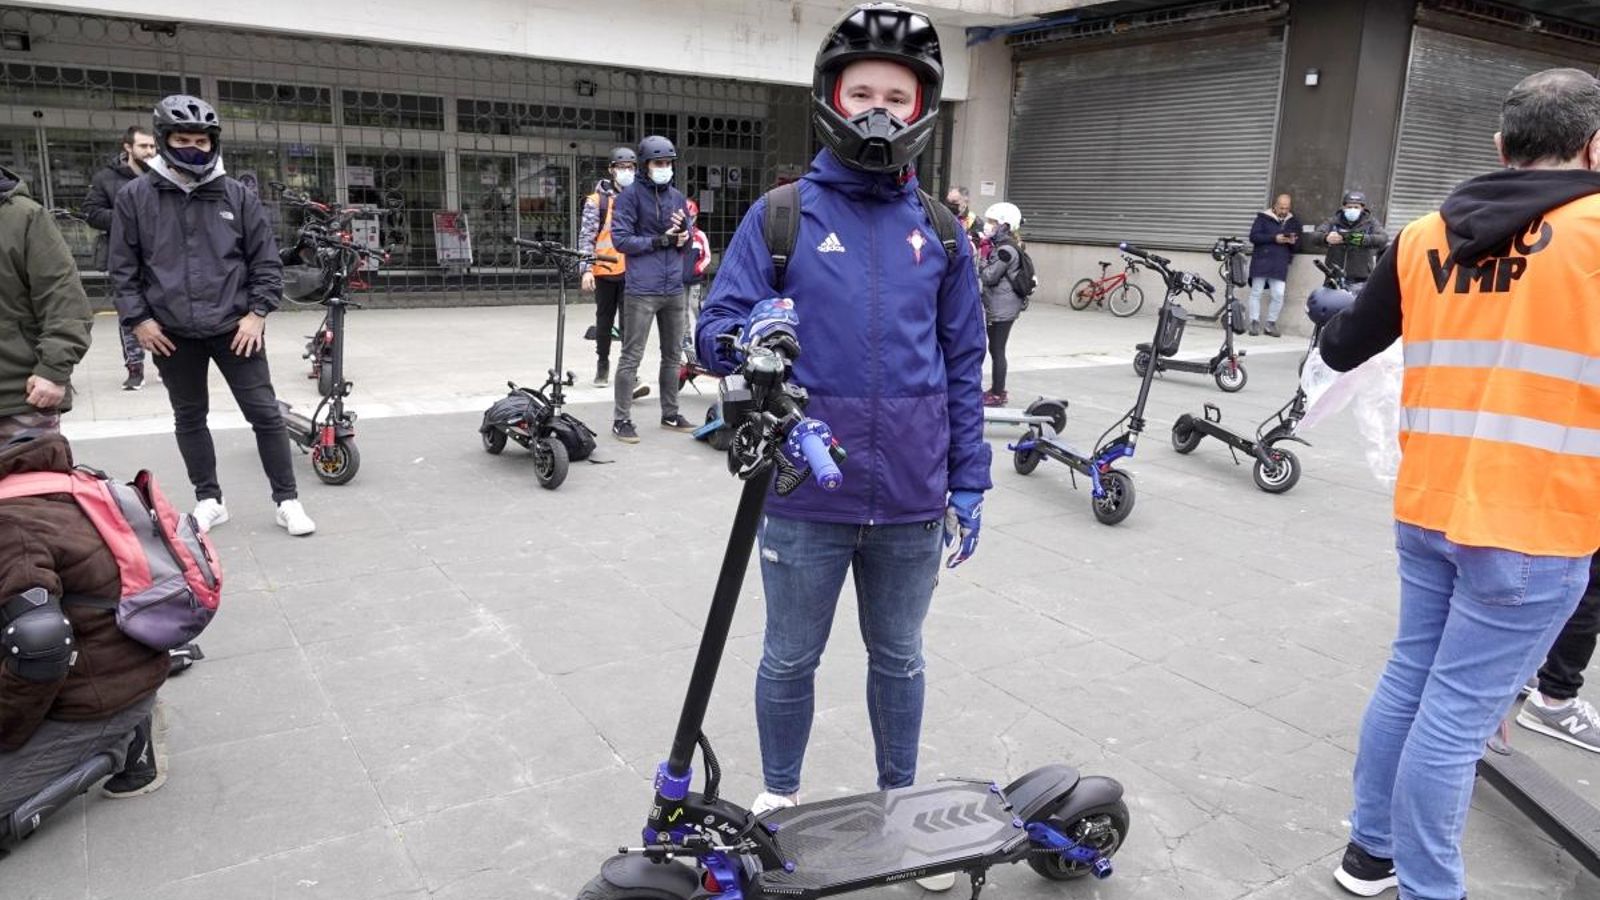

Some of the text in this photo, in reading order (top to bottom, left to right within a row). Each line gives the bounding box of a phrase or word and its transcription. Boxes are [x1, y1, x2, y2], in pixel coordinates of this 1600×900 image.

[1427, 249, 1527, 293] VMP
[1559, 715, 1589, 735] N
[886, 871, 917, 882] MANTIS
